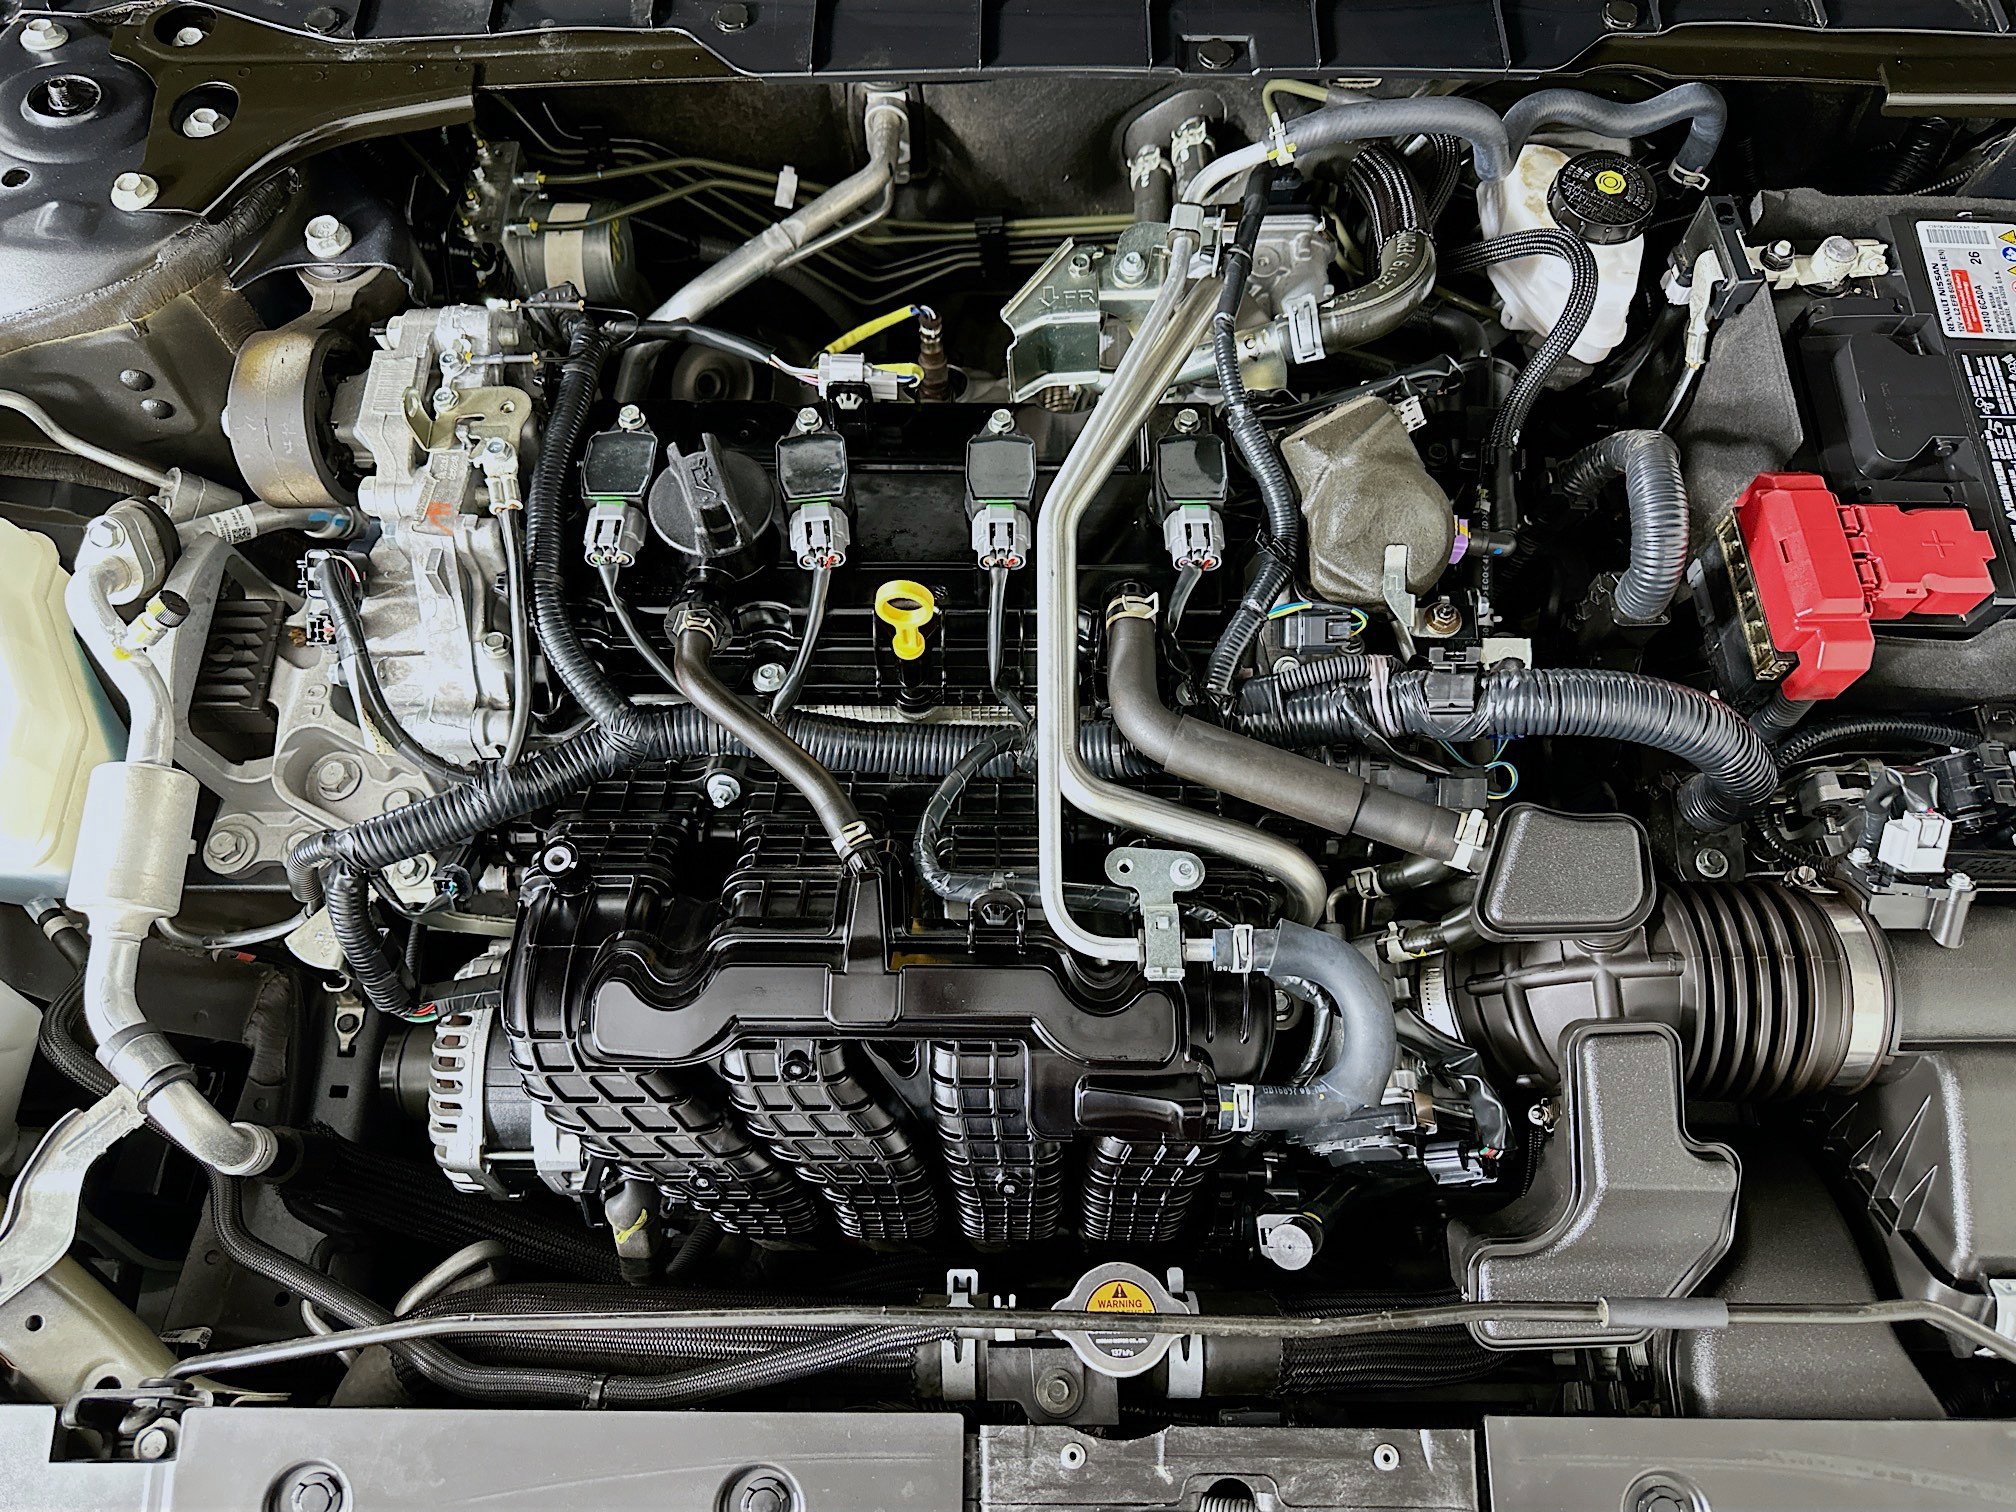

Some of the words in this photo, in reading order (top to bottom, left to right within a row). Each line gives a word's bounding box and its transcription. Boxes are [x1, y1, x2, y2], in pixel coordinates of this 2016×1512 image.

[1969, 251, 1982, 265] 26
[1931, 262, 1947, 296] NISSAN
[1063, 289, 1095, 305] FR
[1941, 299, 1956, 332] RENAULT
[1981, 311, 1994, 333] 24410
[1956, 321, 1965, 332] 12V
[1098, 1300, 1142, 1308] WARNING
